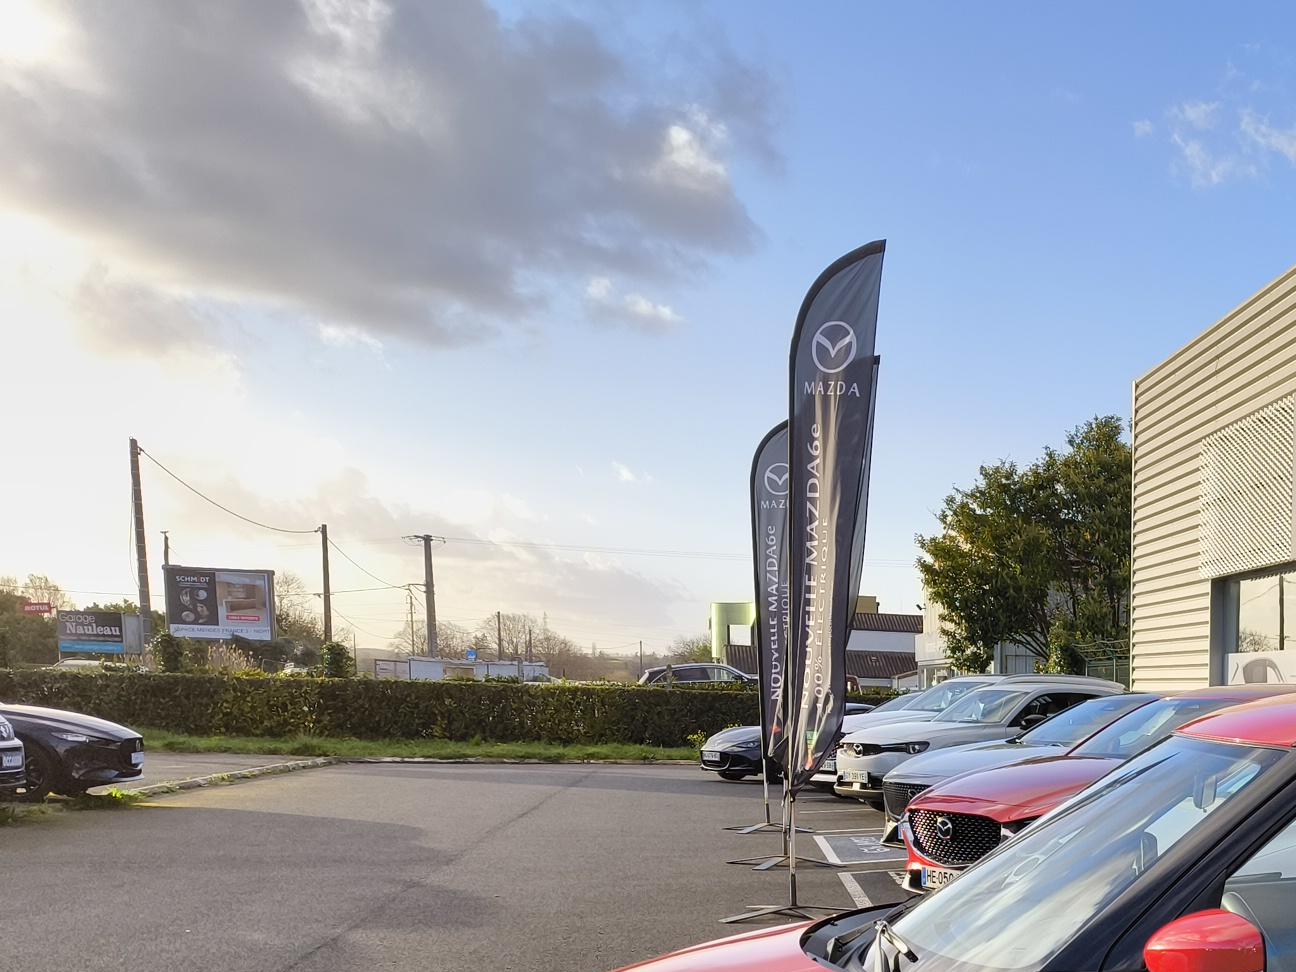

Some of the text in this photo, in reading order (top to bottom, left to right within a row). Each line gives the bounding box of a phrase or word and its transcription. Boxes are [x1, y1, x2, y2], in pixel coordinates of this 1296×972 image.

[803, 381, 860, 397] MAZDA
[760, 500, 789, 510] MAZ
[800, 423, 821, 710] NOUVELLE MAZDA6e
[60, 613, 95, 624] Garage
[766, 525, 782, 701] NOUVELLE MAZDA6e
[66, 622, 120, 635] Nauleau
